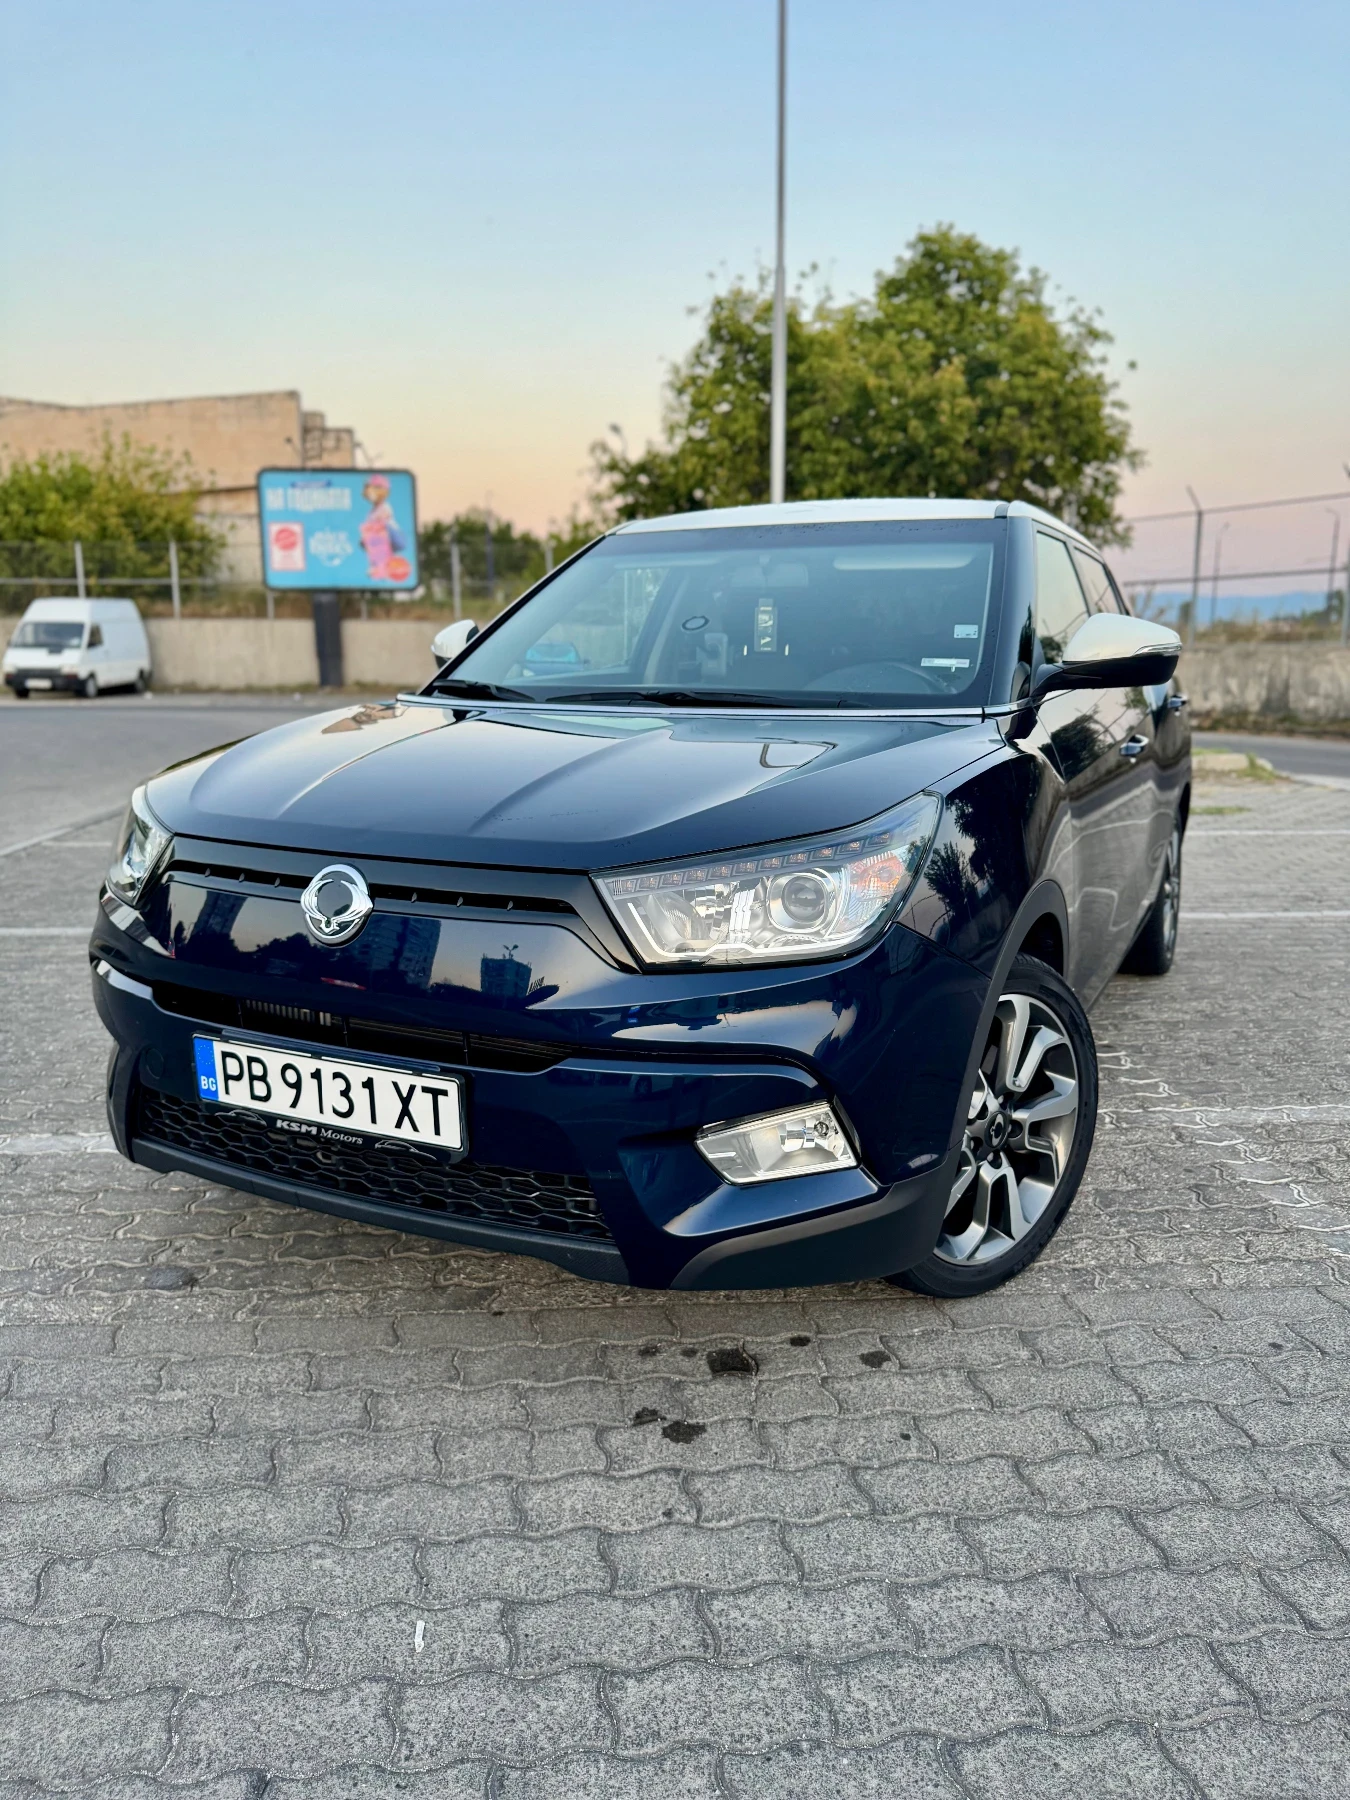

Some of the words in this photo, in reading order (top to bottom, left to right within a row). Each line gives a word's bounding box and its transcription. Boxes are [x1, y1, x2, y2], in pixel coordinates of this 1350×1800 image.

[200, 1075, 217, 1092] BG
[220, 1050, 272, 1103] PB
[280, 1062, 378, 1125] 9131
[391, 1080, 449, 1137] XT
[275, 1118, 318, 1136] KSM
[319, 1127, 364, 1145] Motors
